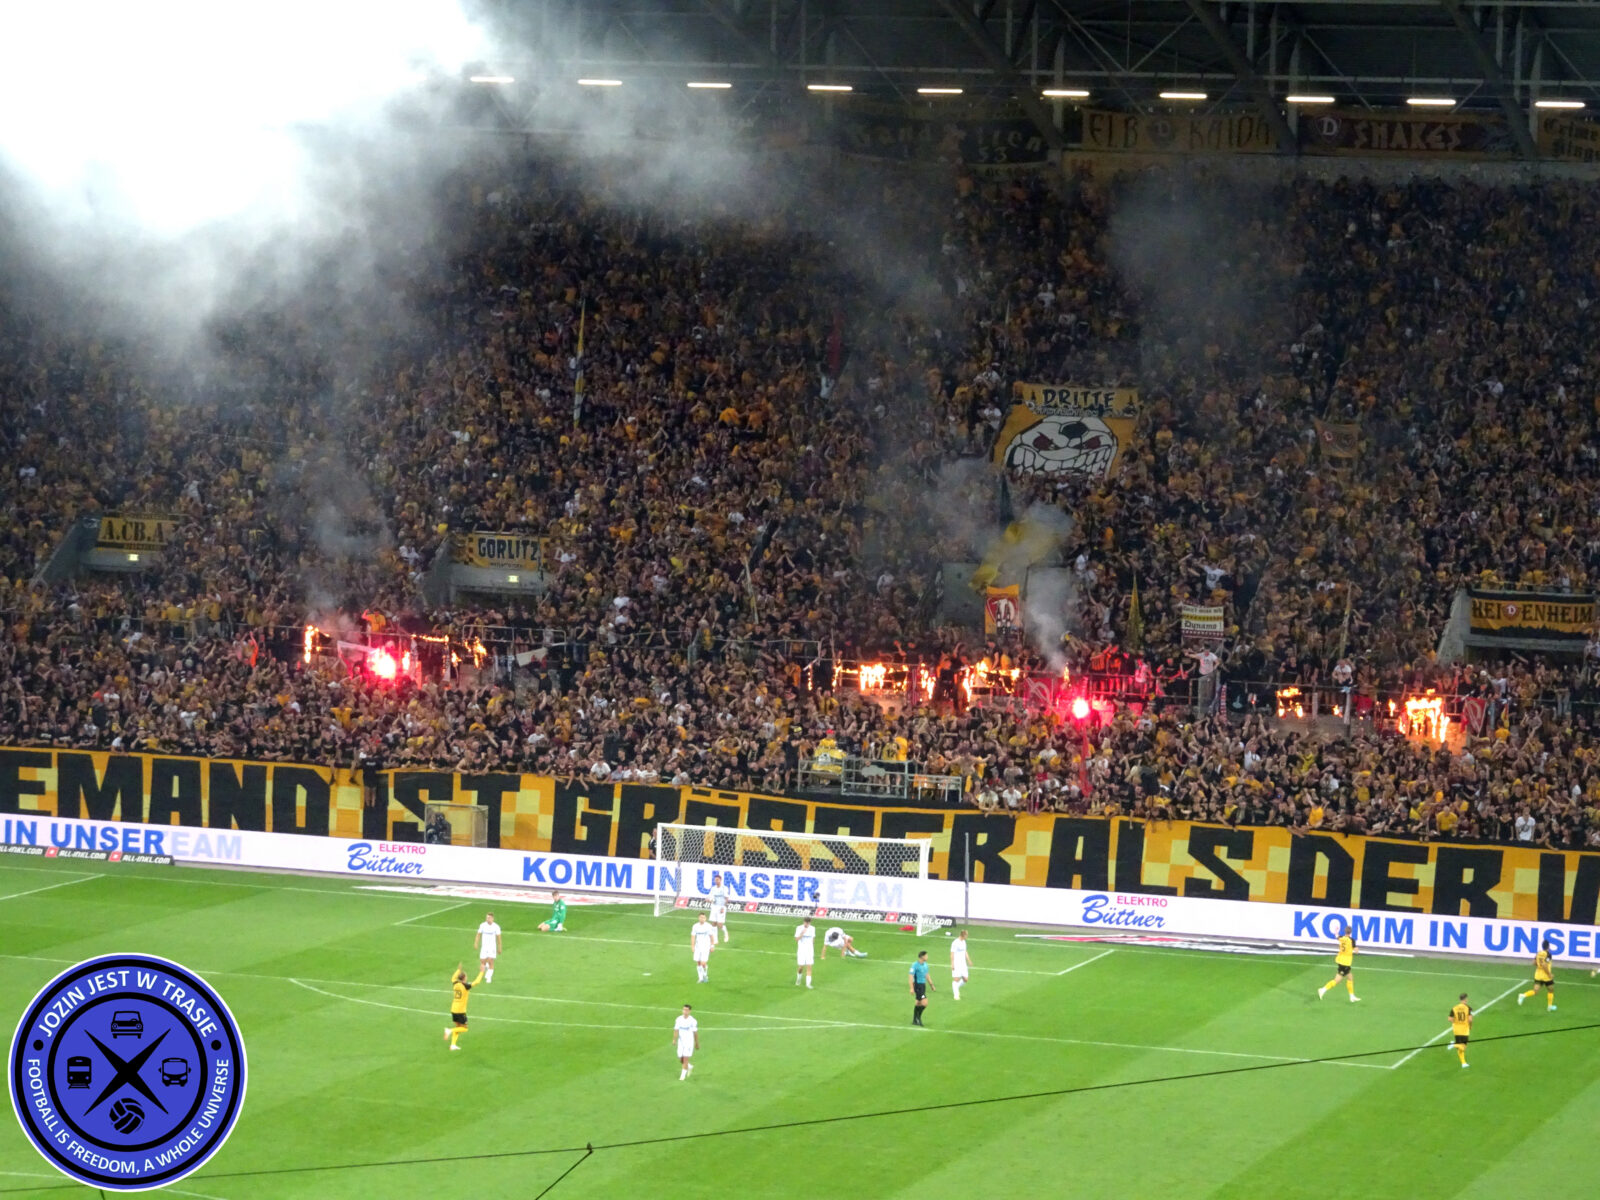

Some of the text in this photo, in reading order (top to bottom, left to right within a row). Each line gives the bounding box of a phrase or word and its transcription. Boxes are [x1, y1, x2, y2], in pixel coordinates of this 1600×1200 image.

[1042, 388, 1116, 409] DRITTE
[4, 819, 38, 847] IN
[51, 822, 165, 856] UNSER
[363, 769, 521, 849] IST
[552, 776, 1017, 886] GRÖSSER
[1046, 816, 1255, 902] ALS
[1285, 833, 1504, 919] DER
[379, 842, 427, 855] ELEKTRO
[347, 842, 425, 876] Büttner
[522, 856, 633, 889] KOMM
[646, 865, 681, 892] IN
[696, 868, 820, 903] UNSER
[1081, 894, 1165, 929] Büttner
[1117, 895, 1168, 908] ELEKTRO
[1293, 911, 1414, 945] KOMM
[1429, 920, 1468, 949] IN
